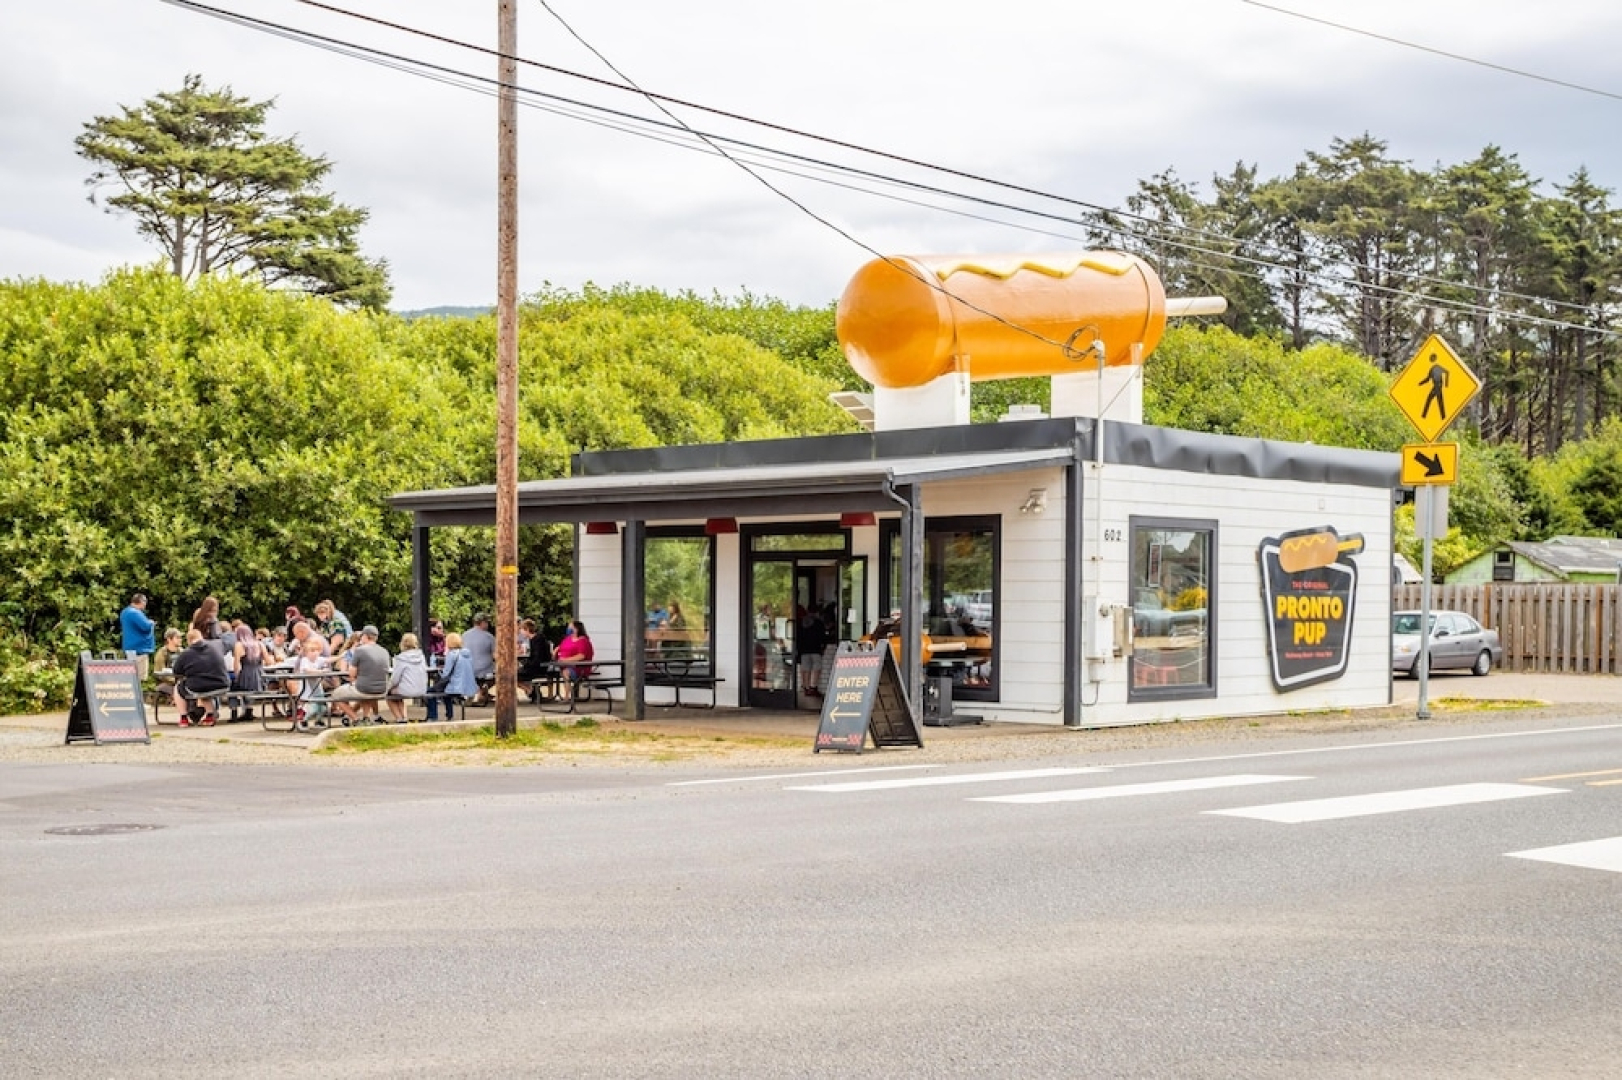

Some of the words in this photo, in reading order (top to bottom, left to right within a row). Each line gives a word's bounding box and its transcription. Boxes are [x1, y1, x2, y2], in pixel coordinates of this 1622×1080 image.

[1104, 529, 1121, 541] 602
[1276, 596, 1343, 620] PRONTO
[1293, 622, 1327, 645] PUP
[836, 677, 869, 688] ENTER
[836, 691, 862, 702] HERE
